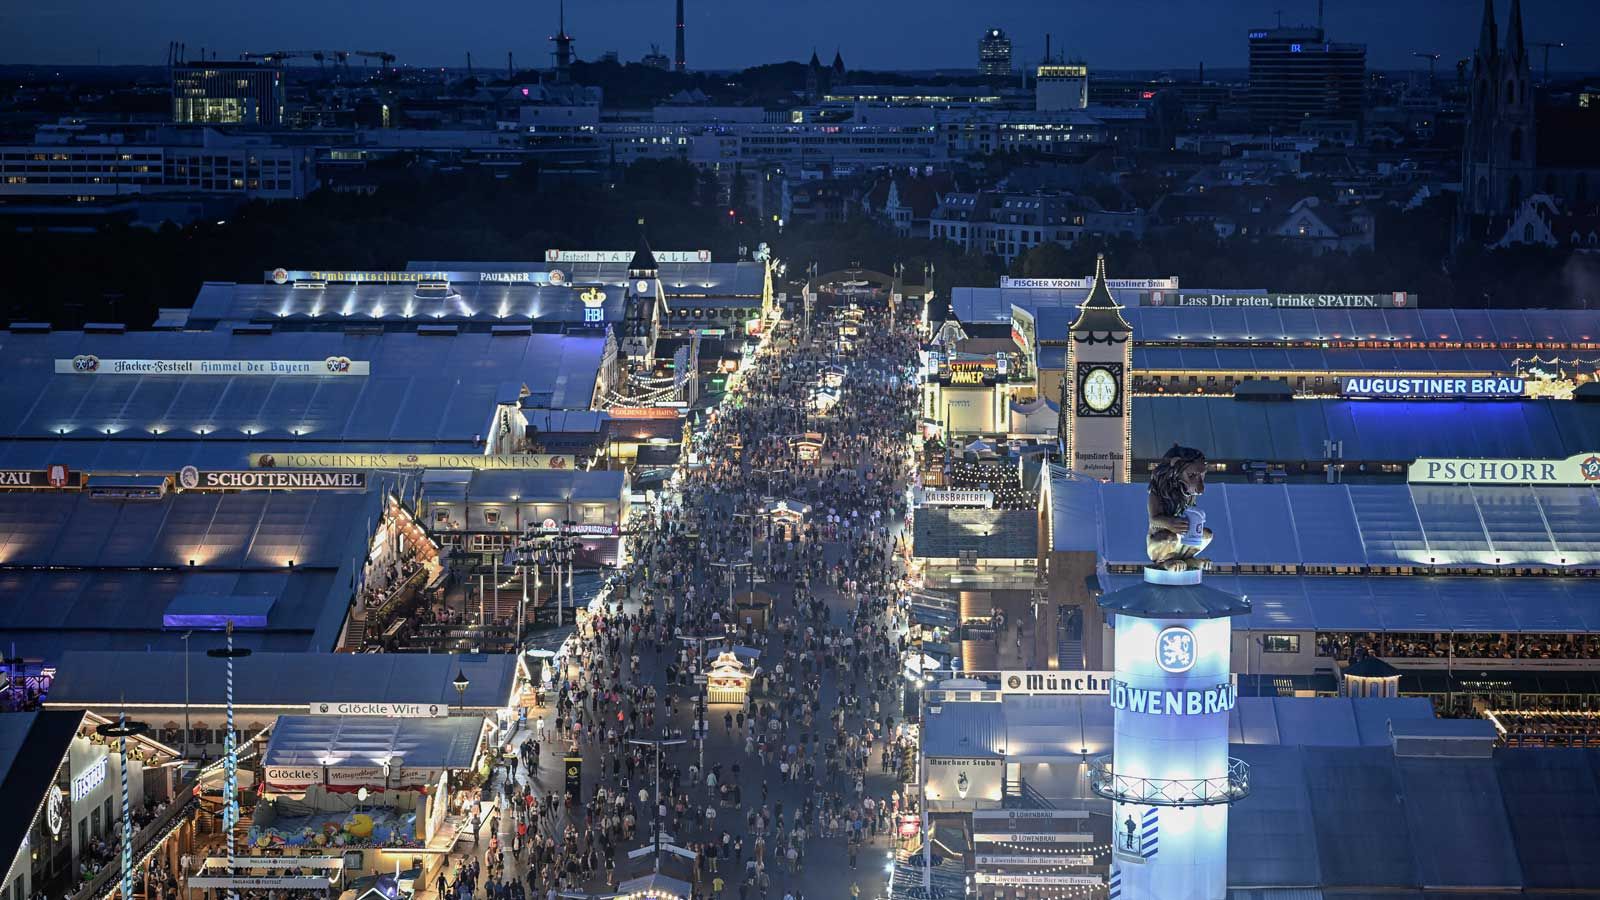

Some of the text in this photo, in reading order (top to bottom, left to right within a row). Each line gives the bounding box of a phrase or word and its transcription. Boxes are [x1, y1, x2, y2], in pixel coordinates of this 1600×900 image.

[597, 252, 689, 262] MARALL
[311, 271, 448, 281] Armbrustschützenzelt
[480, 272, 530, 281] PAULANER
[1013, 279, 1081, 288] FISCHER VRONI
[1105, 279, 1146, 290] ugustiner
[1178, 294, 1378, 308] Lass Dir raten, trinke SPATEN.
[201, 361, 242, 373] Himmel
[247, 361, 263, 372] der
[270, 361, 310, 374] Bayern
[950, 371, 984, 383] AMMER
[1346, 377, 1523, 393] AUGUSTINER BRÄU
[287, 454, 388, 467] POSCHNER'S
[439, 454, 541, 467] POSCHNER'S
[1427, 462, 1557, 480] PSCHORR
[207, 473, 362, 486] SCHOTTENHAMEL
[1110, 678, 1236, 715] LÖWENBRÄU
[338, 703, 420, 714] Glöckle Wirt
[269, 769, 319, 780] Glöckle's
